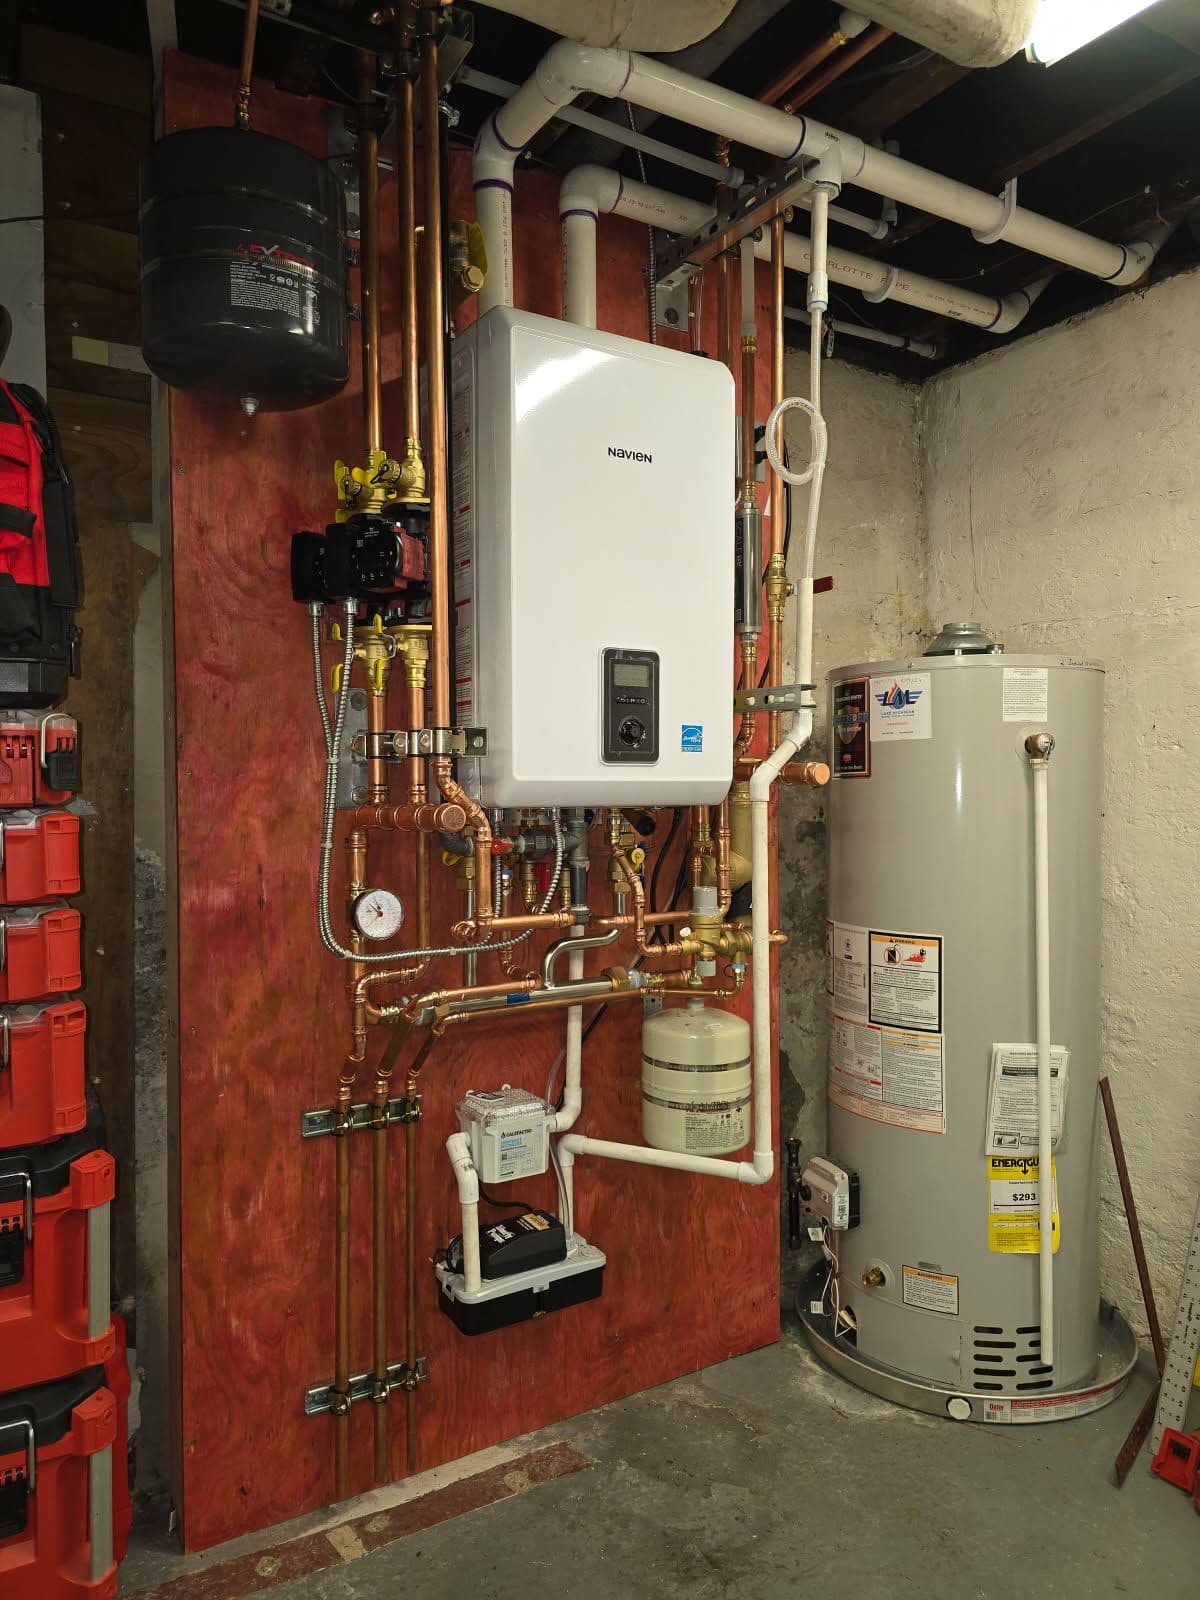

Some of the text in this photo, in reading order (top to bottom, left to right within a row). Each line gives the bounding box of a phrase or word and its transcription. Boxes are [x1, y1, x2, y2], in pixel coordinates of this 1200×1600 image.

[802, 252, 874, 280] CRLOTTE
[607, 446, 653, 463] Navien
[991, 1158, 1040, 1171] ENERGYGU
[1012, 1192, 1037, 1202] $293
